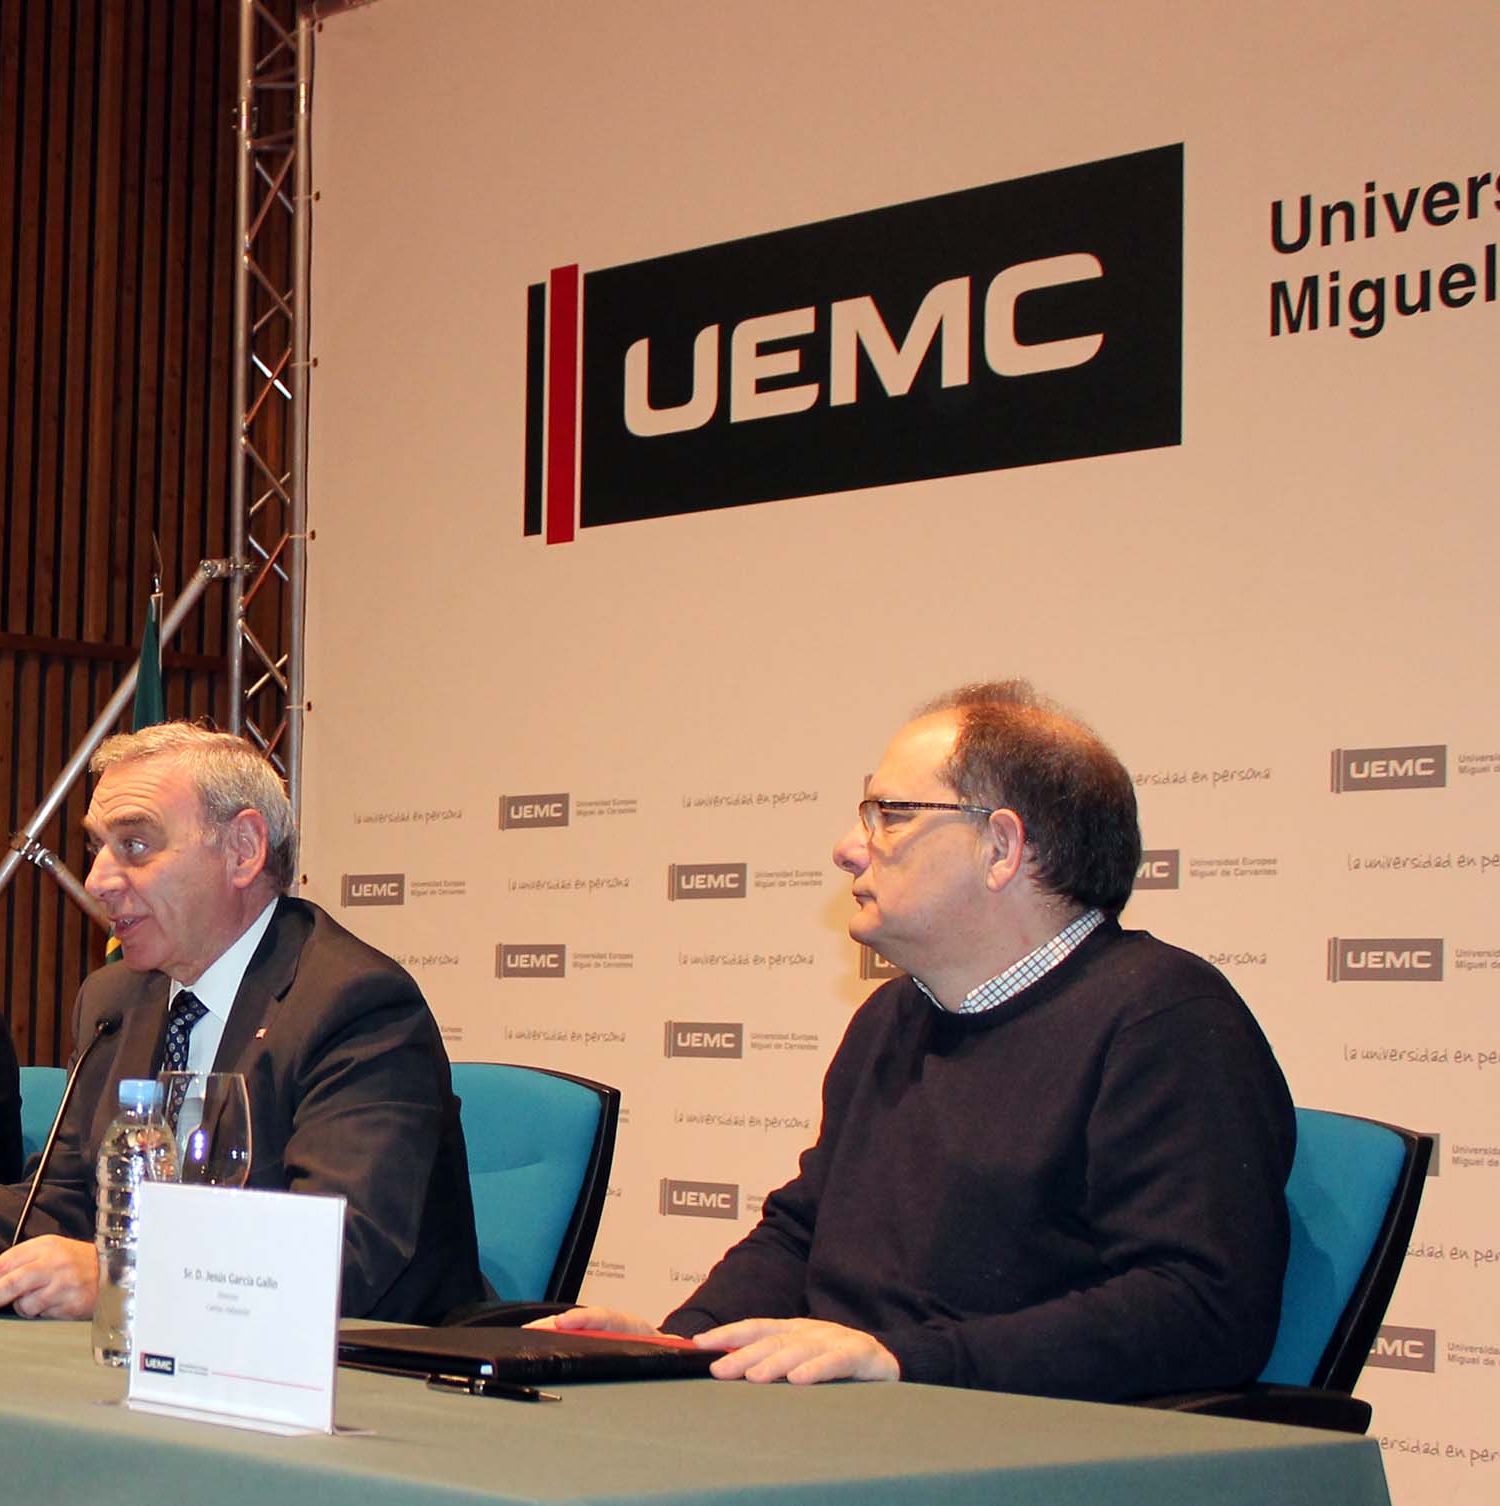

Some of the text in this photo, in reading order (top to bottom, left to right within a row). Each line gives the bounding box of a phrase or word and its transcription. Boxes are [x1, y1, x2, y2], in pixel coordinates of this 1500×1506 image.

[1270, 170, 1500, 255] Univer
[1270, 243, 1497, 339] Miguel
[623, 252, 1104, 438] UEMC
[1349, 757, 1436, 779] UEMC
[1135, 767, 1272, 789] ersidad en persona
[510, 803, 563, 819] UEMC
[1136, 861, 1171, 879] MC
[1348, 852, 1361, 871] la
[1364, 852, 1452, 870] universidad
[1457, 854, 1477, 868] en
[351, 882, 399, 897] UEMC
[680, 873, 740, 889] UEMC
[507, 953, 559, 968] UEMC
[1346, 951, 1433, 969] UEMC
[676, 1032, 736, 1048] UEMC
[1343, 1043, 1358, 1062] la
[1360, 1047, 1449, 1064] universidad
[1453, 1050, 1474, 1064] en
[671, 1190, 732, 1209] UEMC
[1449, 1246, 1469, 1261] en
[1370, 1337, 1425, 1359] MC
[145, 1356, 174, 1372] UEMC
[1380, 1436, 1440, 1457] ersidad
[1445, 1444, 1466, 1459] en
